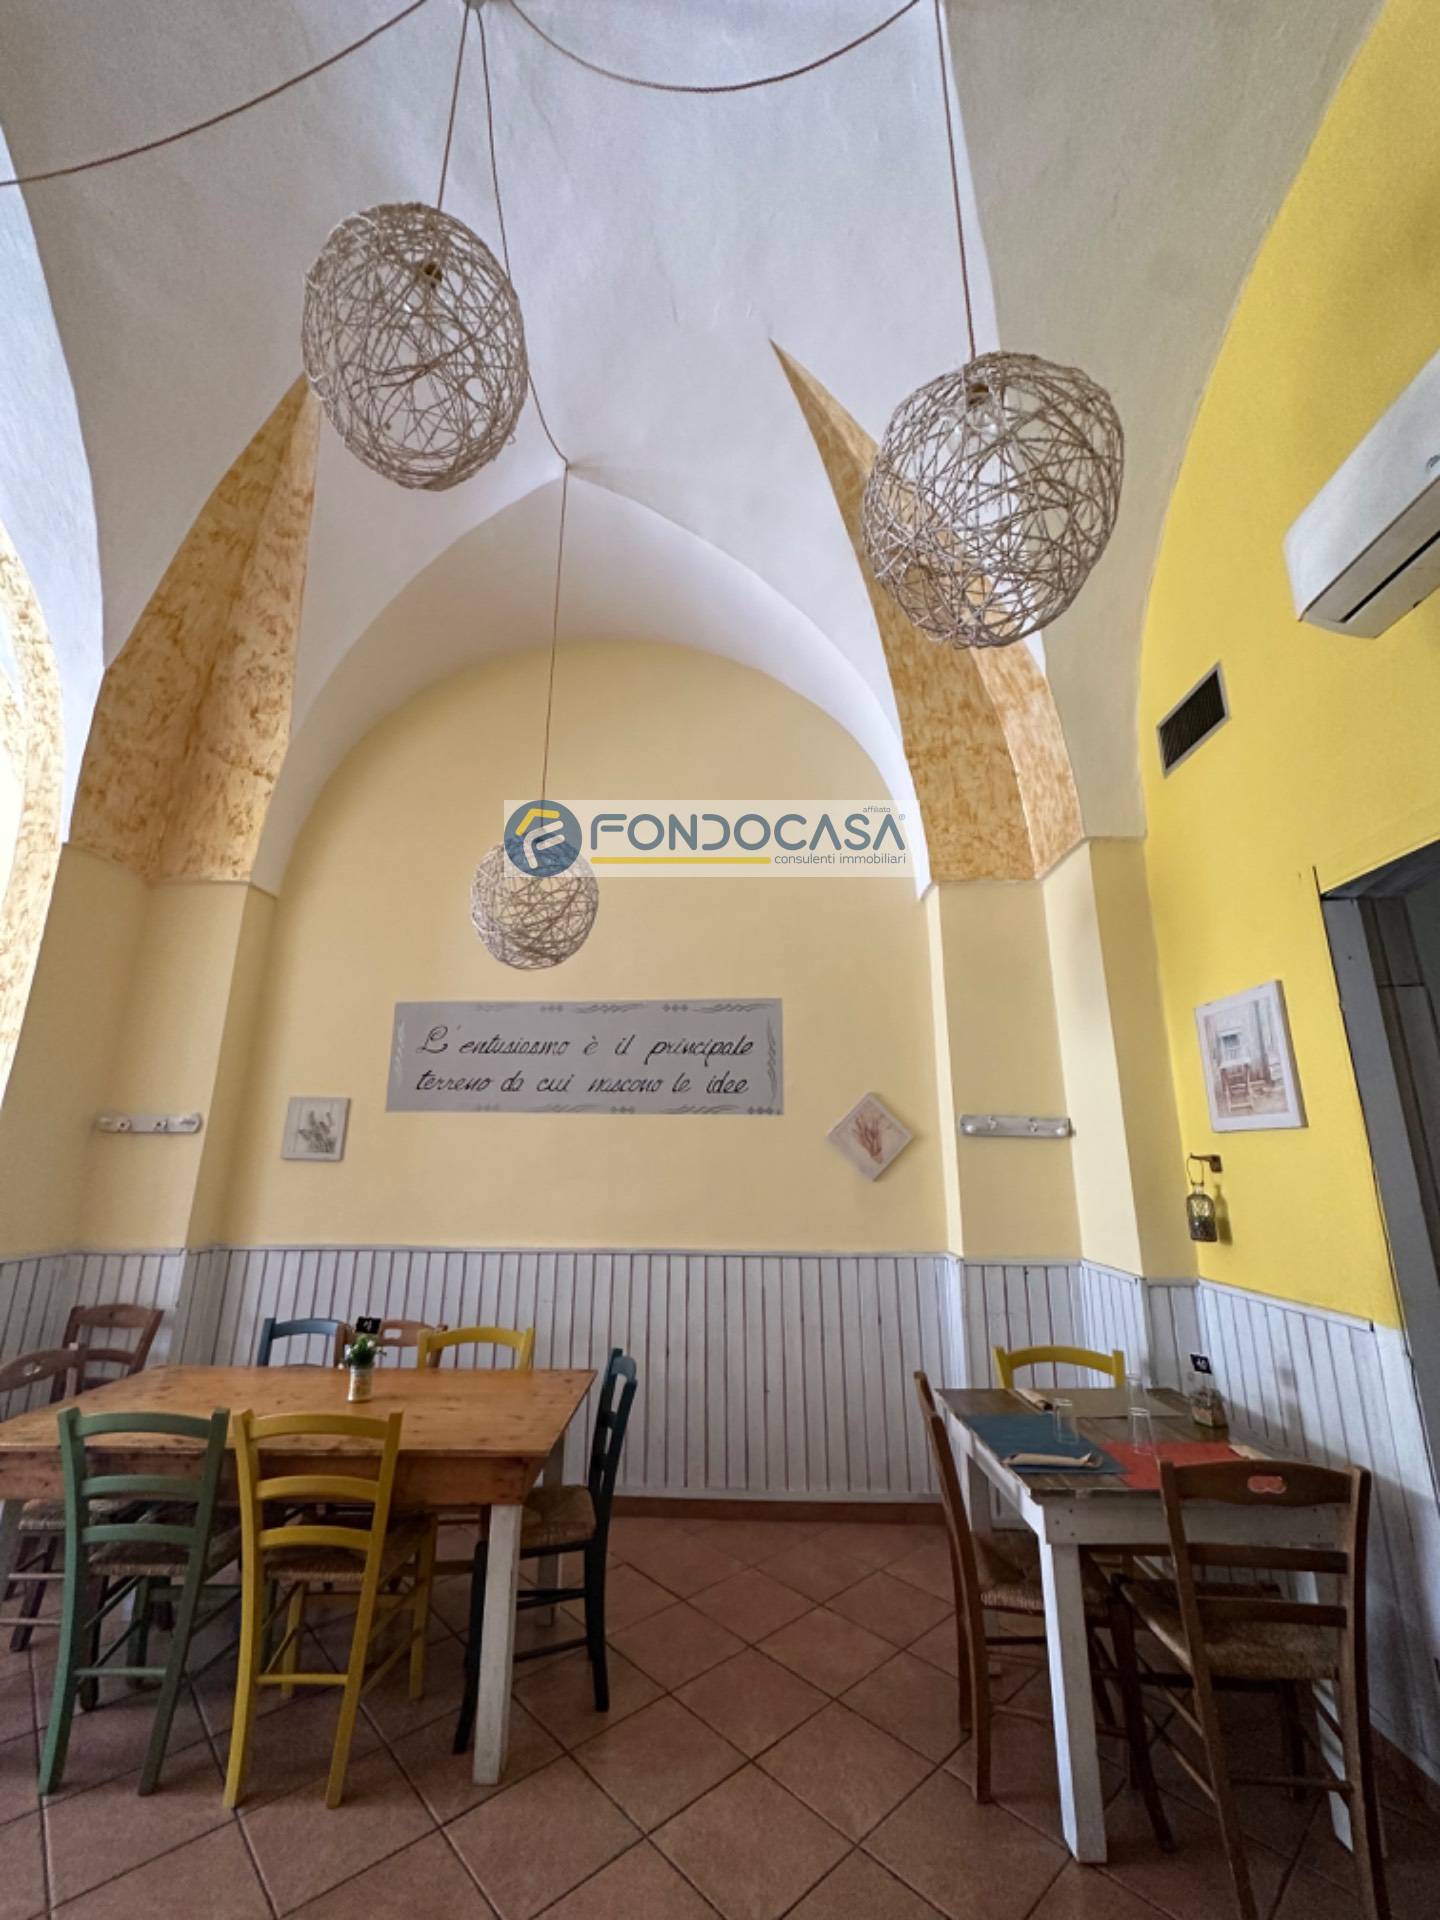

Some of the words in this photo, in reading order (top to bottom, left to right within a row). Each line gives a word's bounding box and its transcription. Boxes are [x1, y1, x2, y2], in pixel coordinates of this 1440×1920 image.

[583, 1035, 600, 1056] è
[614, 1034, 636, 1056] il
[643, 1034, 754, 1067] principale
[416, 1070, 492, 1092] terreno
[500, 1070, 525, 1092] da
[536, 1074, 575, 1092] cui
[587, 1077, 664, 1093] nascono
[671, 1072, 691, 1093] le
[706, 1070, 750, 1094] idee
